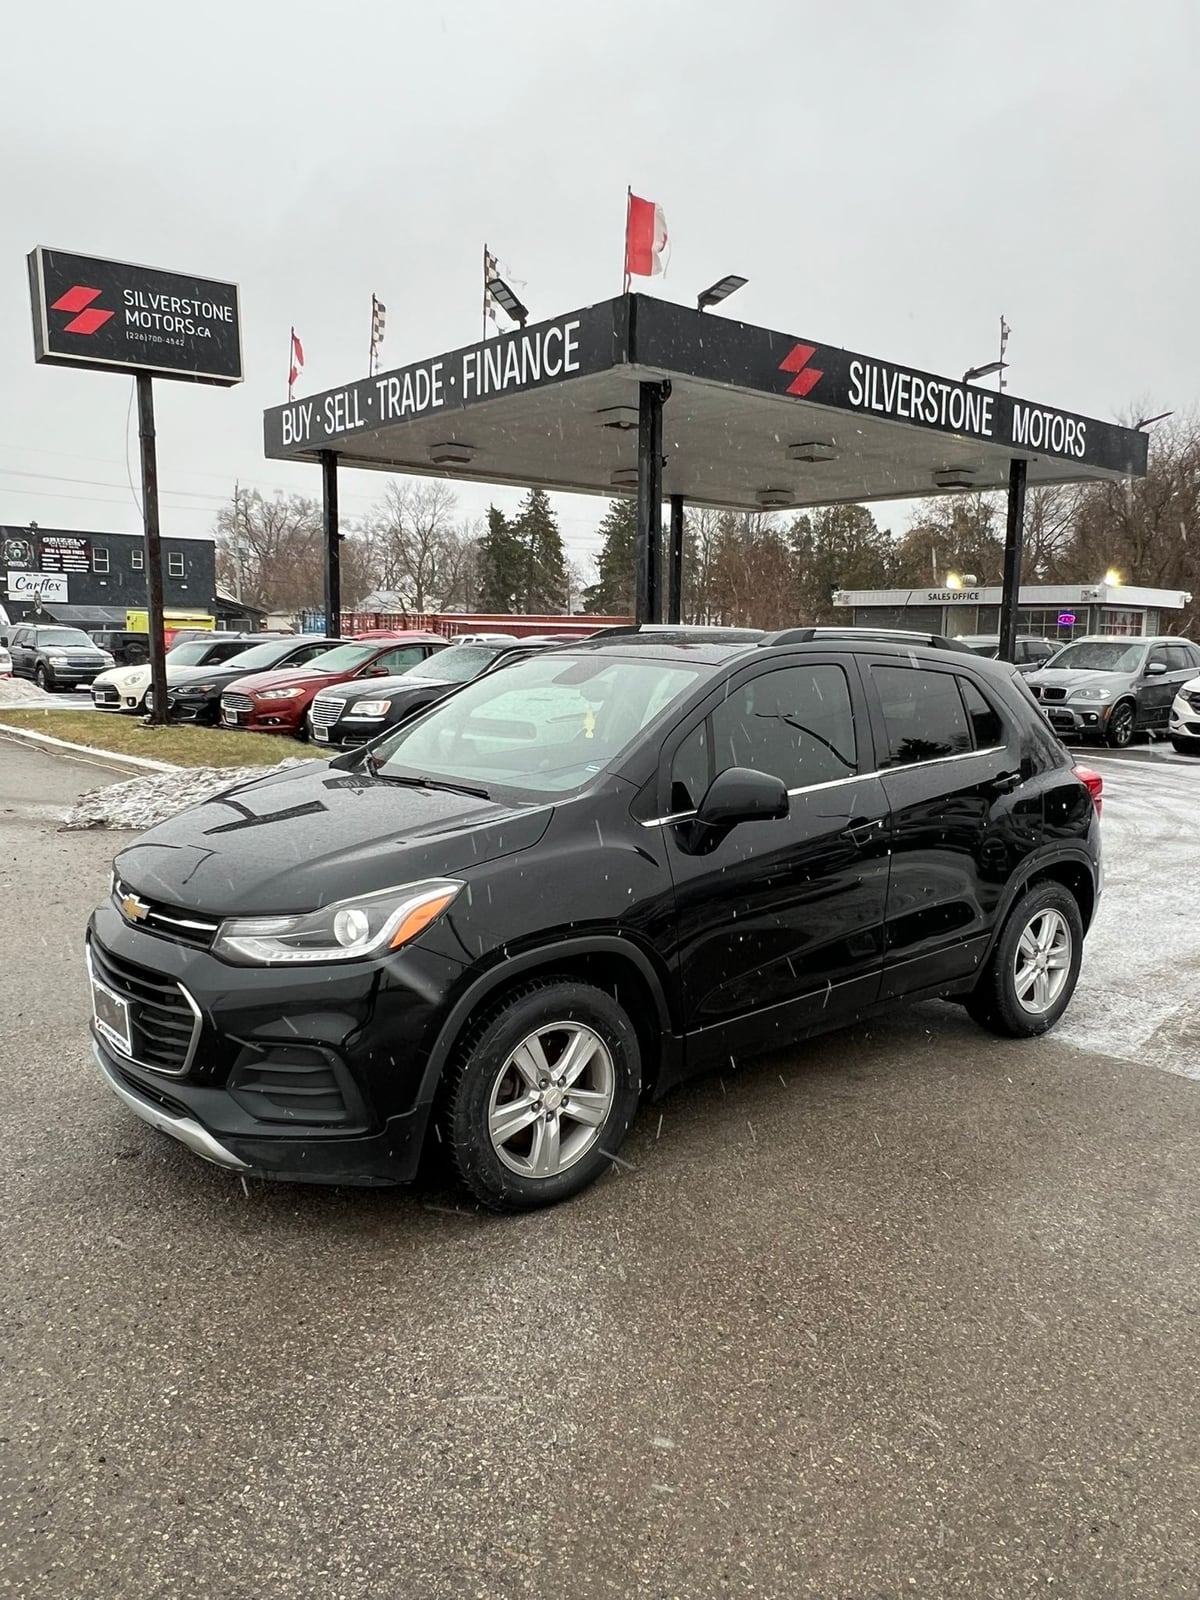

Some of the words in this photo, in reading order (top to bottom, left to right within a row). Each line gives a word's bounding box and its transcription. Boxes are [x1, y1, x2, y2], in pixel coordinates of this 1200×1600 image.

[123, 289, 233, 323] SILVERSTONE
[125, 309, 212, 338] MOTORS.CA
[282, 402, 314, 446] BUY
[324, 388, 365, 435] SELL
[376, 362, 444, 421] TRADE
[462, 320, 581, 399] FINANCE
[848, 360, 994, 437] SILVERSTONE
[1012, 404, 1086, 458] MOTORS
[16, 577, 60, 593] Carflex
[928, 592, 951, 601] SALES
[952, 592, 979, 600] OFFICE
